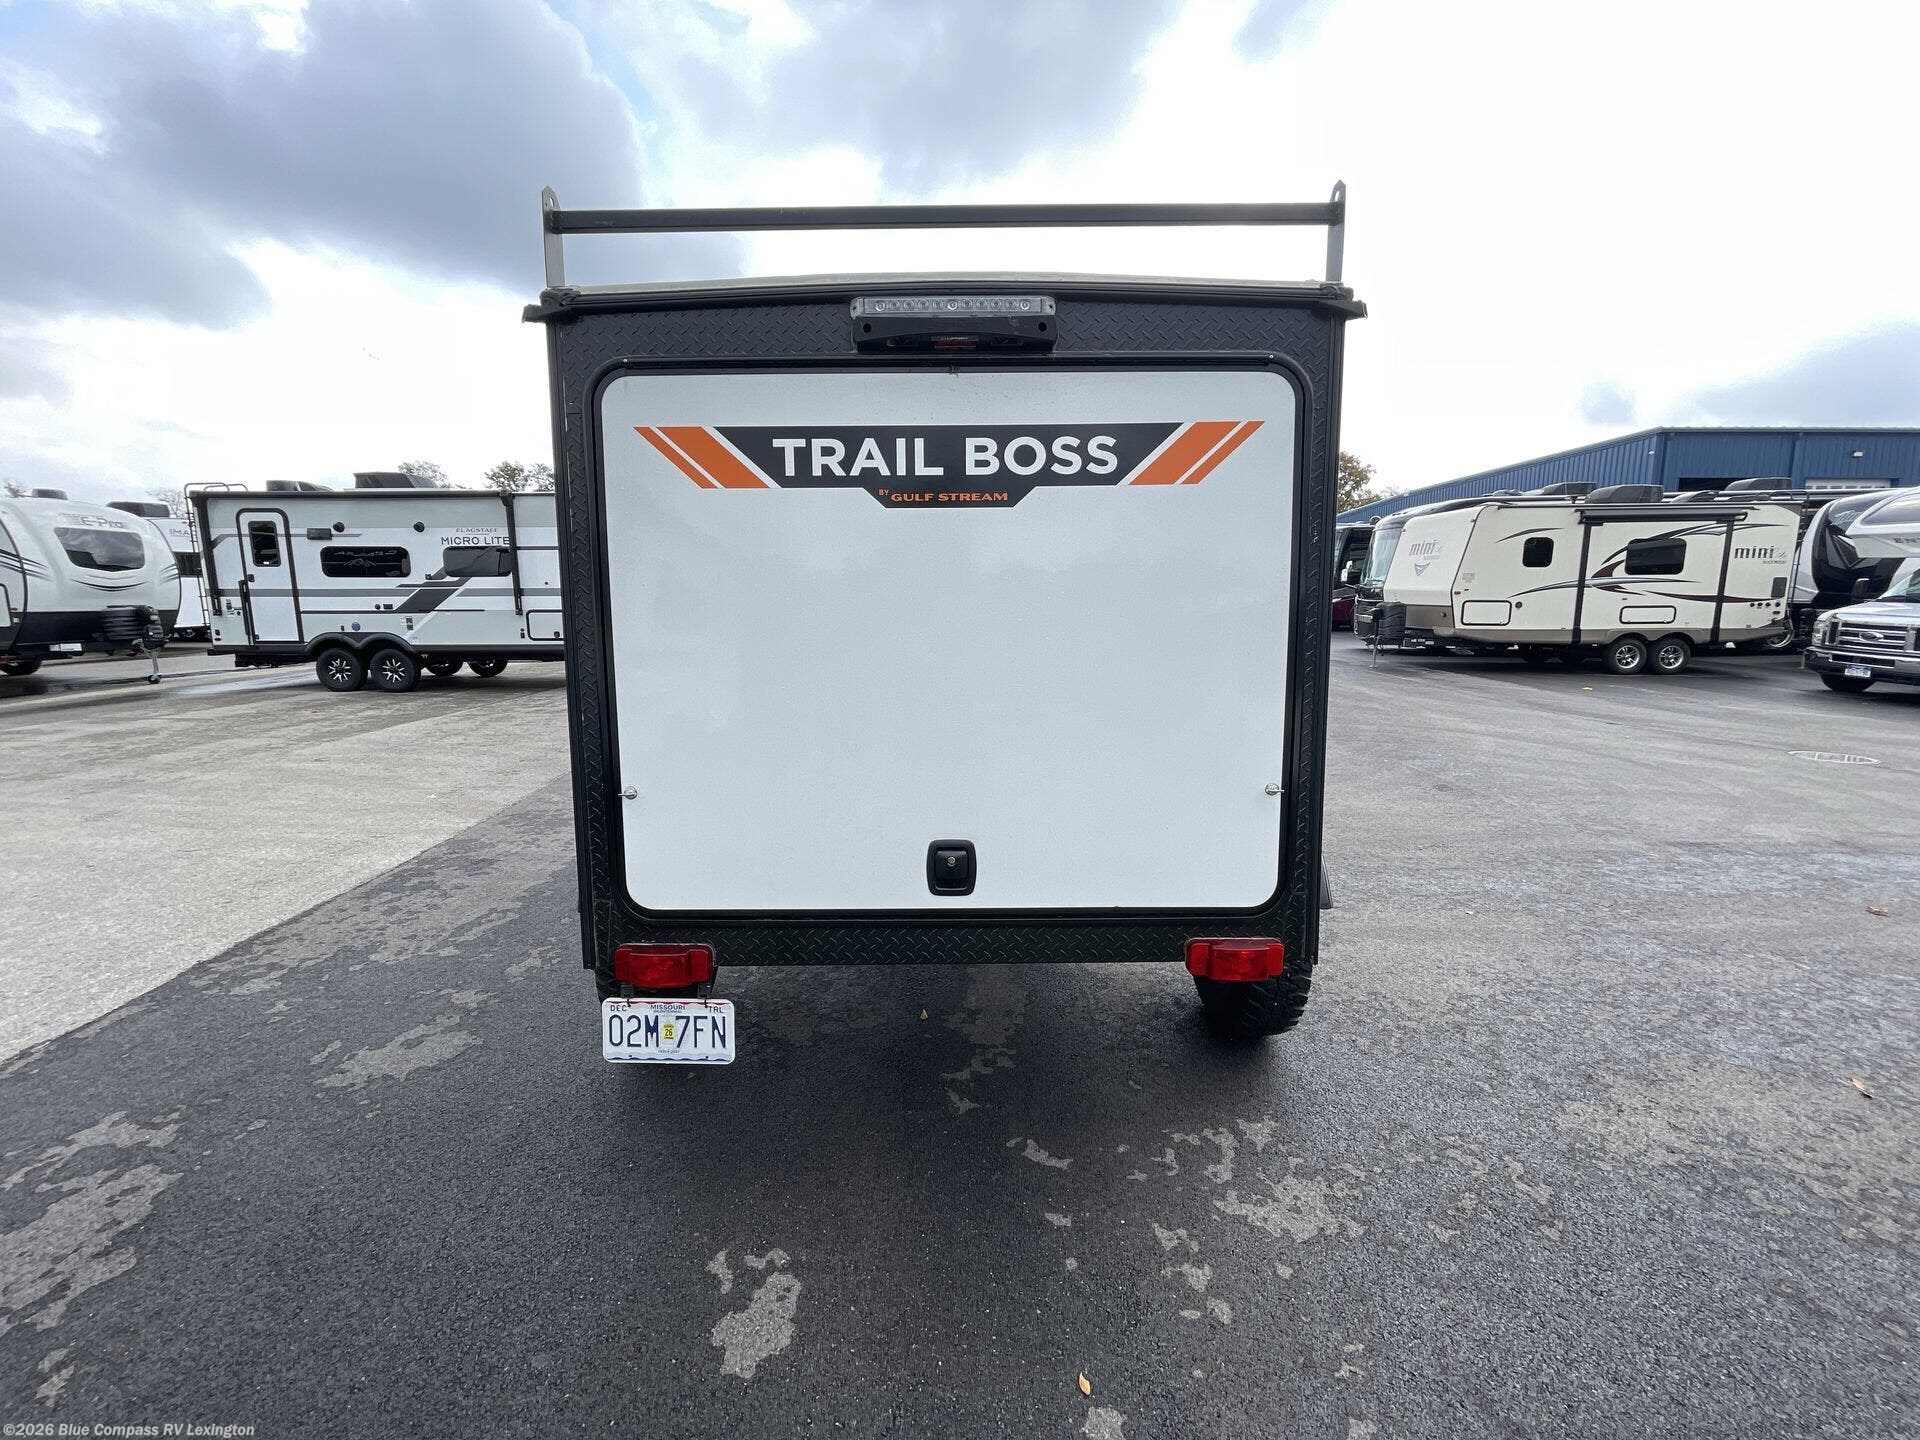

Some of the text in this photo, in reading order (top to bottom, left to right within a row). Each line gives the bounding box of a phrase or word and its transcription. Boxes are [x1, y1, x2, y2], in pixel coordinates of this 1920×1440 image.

[772, 435, 1118, 477] TRAIL BOSS
[878, 488, 1008, 502] BY GULF STREAM
[441, 536, 511, 545] MICRO LITE
[1409, 539, 1437, 555] mini
[1735, 545, 1774, 558] mini
[610, 1004, 627, 1012] DEC
[608, 1014, 726, 1049] 02M 7FN
[664, 1028, 673, 1037] 26
